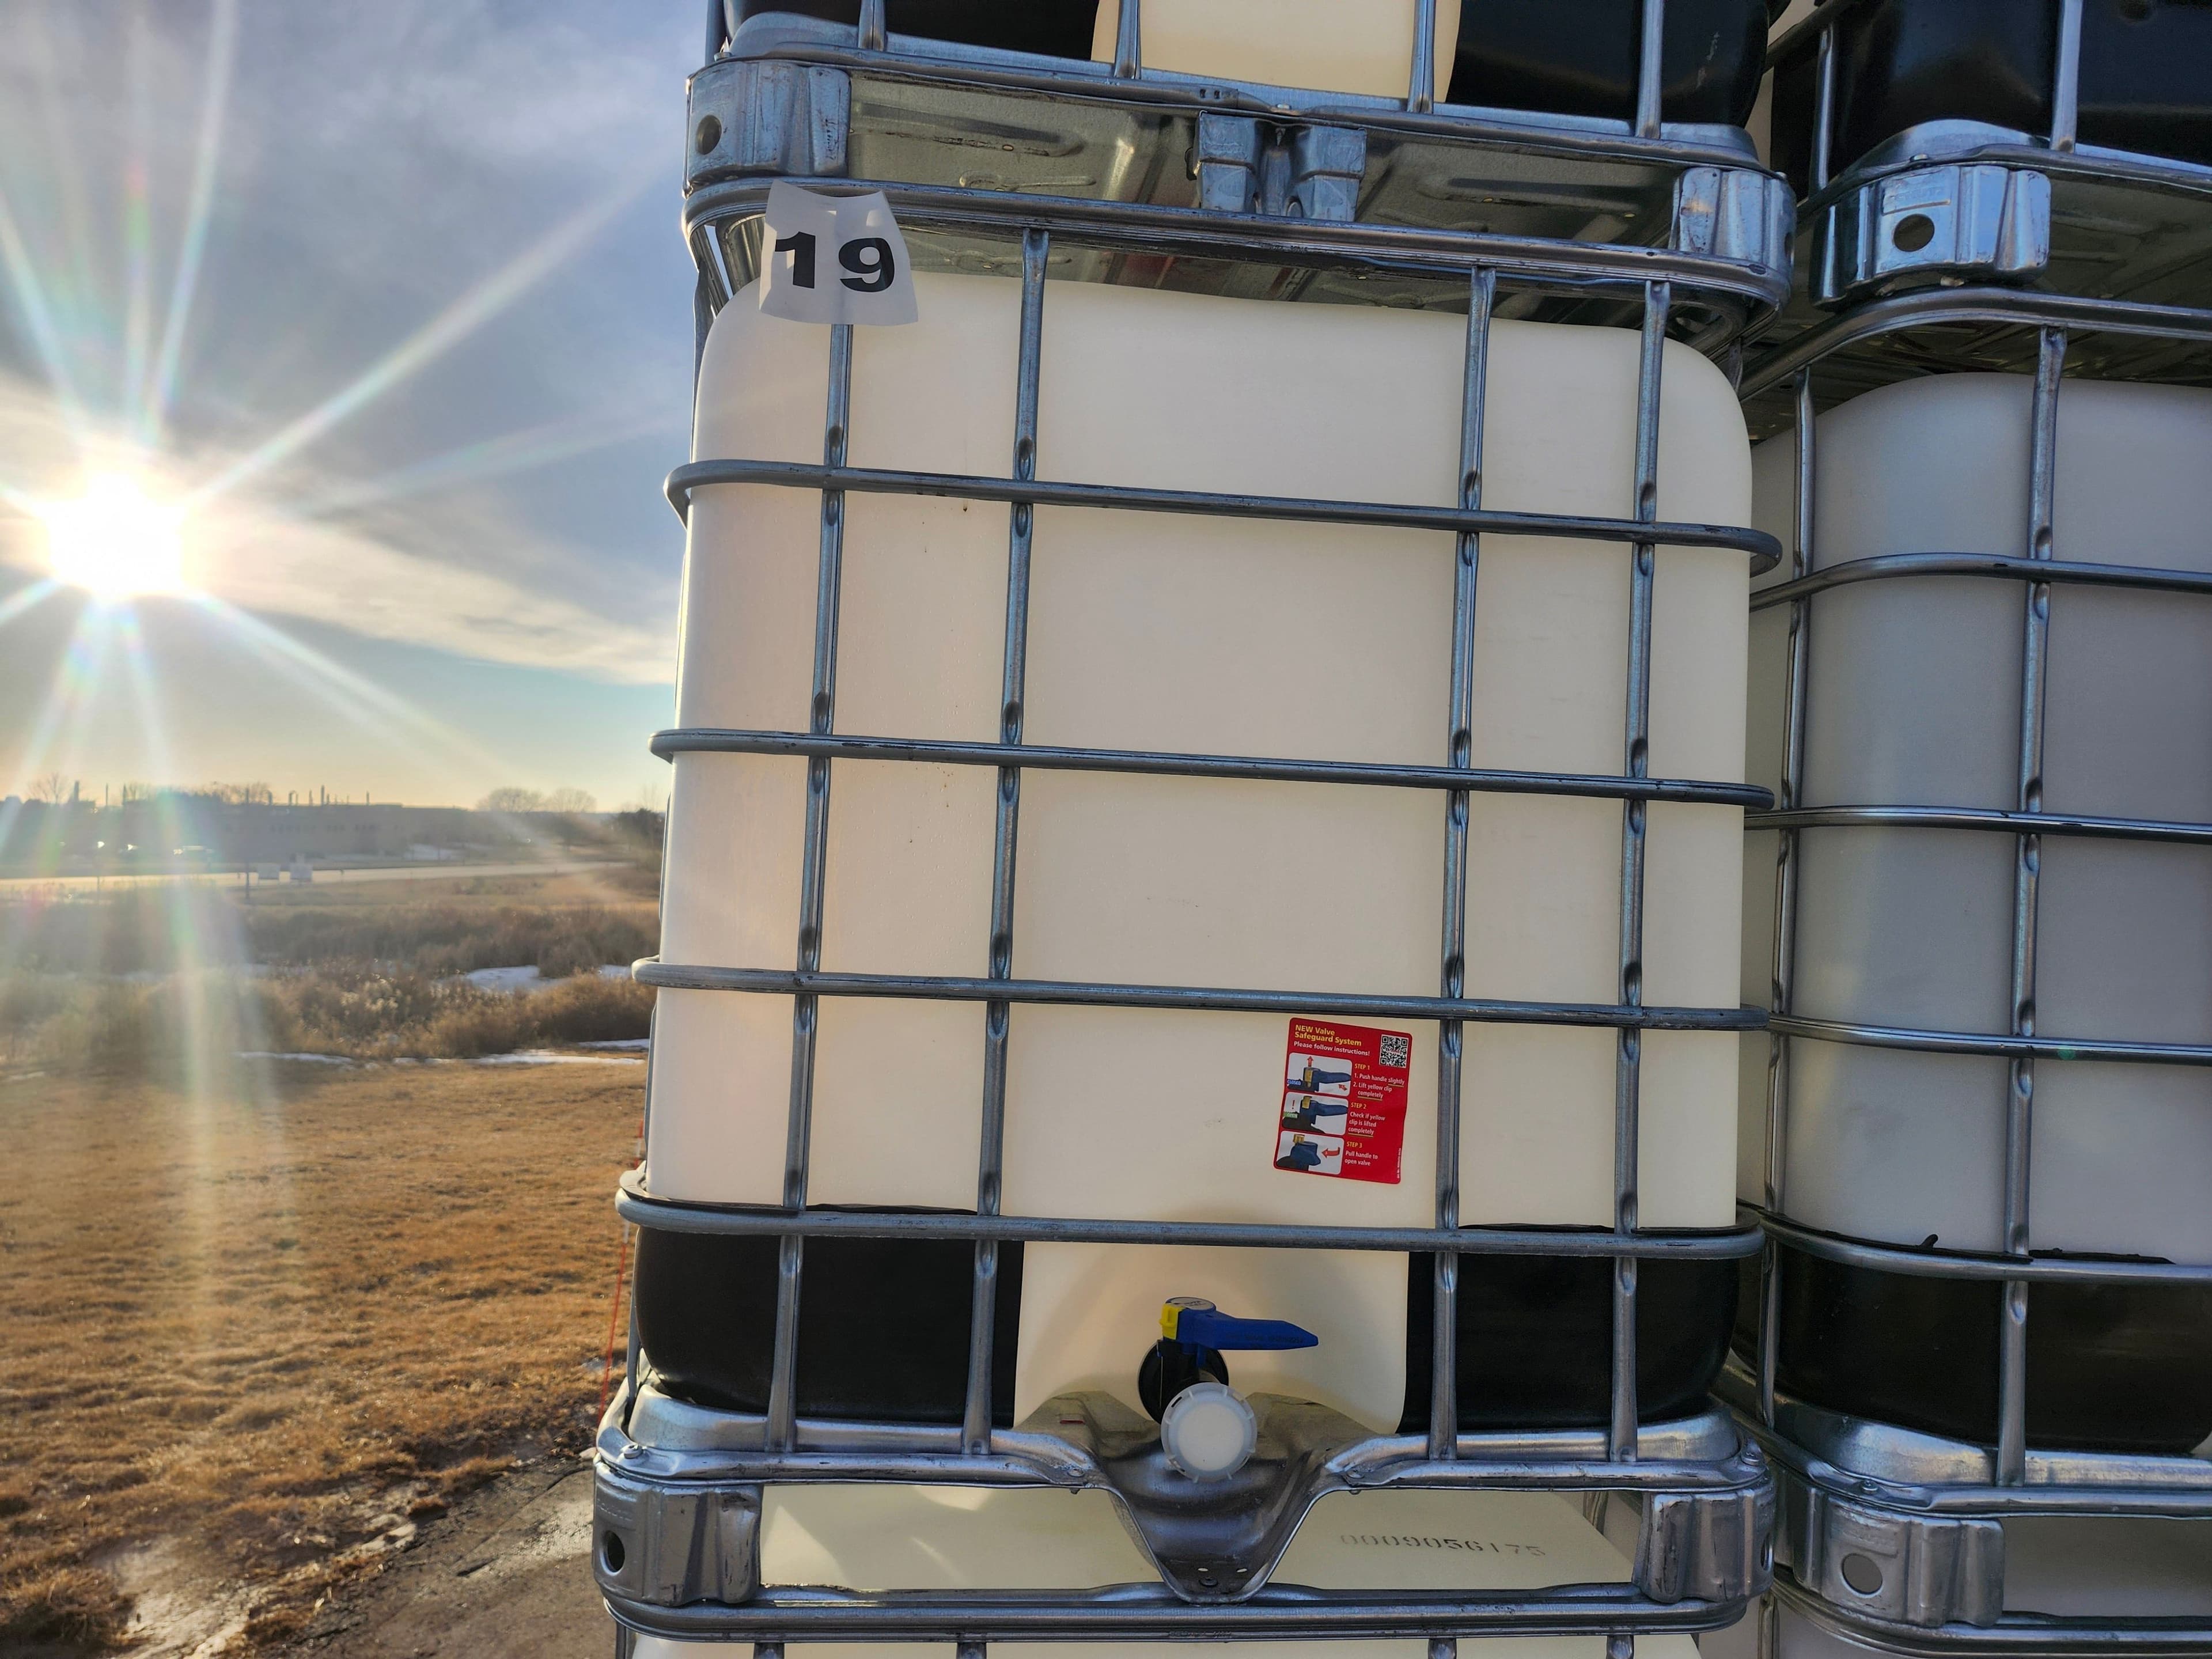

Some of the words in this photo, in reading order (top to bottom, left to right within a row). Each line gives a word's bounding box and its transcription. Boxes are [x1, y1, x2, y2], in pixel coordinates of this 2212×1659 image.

[775, 231, 895, 293] 19
[1315, 1027, 1335, 1036] Valve
[1295, 1032, 1333, 1042] Safeguard
[1335, 1037, 1362, 1046] System
[1334, 1046, 1370, 1055] instructions!
[1388, 1077, 1405, 1085] slightly
[1358, 1090, 1384, 1099] completely
[1348, 1127, 1374, 1135] completely
